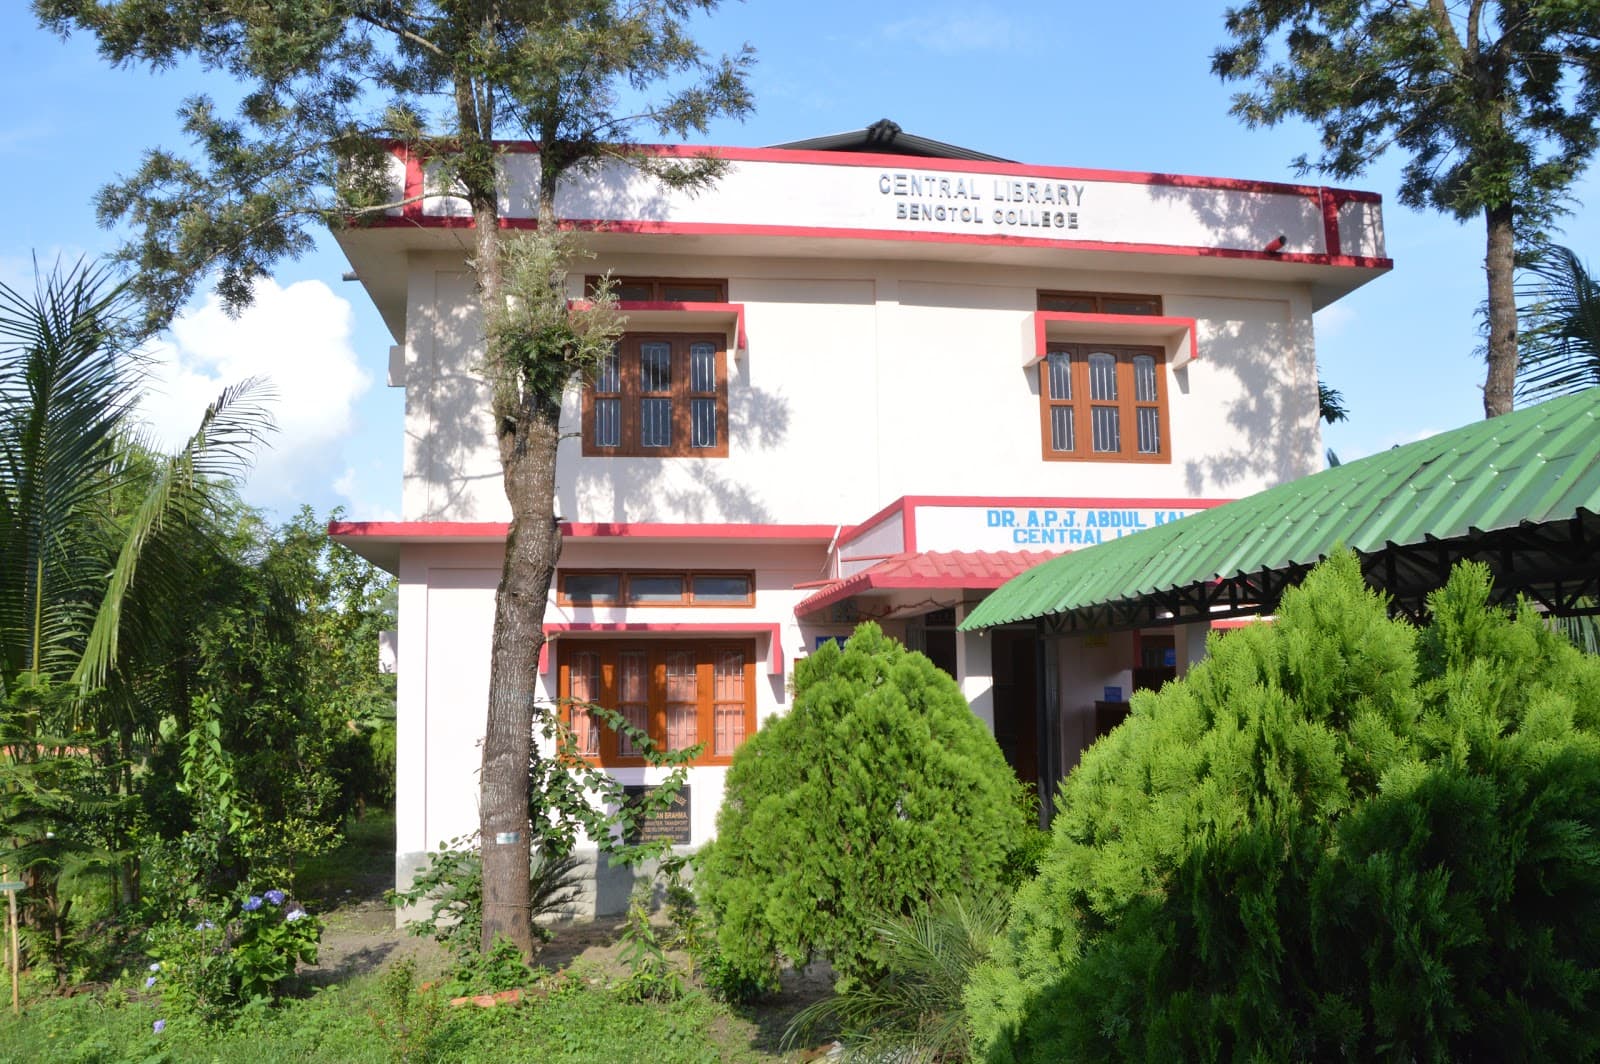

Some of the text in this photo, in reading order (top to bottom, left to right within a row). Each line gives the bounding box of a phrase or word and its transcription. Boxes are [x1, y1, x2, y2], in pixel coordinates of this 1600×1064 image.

[879, 174, 1085, 206] CENTRAL LIBRARY
[896, 201, 1079, 230] BENGTOL COLLEGE
[987, 510, 1020, 527] DR.
[1027, 510, 1081, 528] A.P.J.
[1086, 511, 1147, 527] ABDUL
